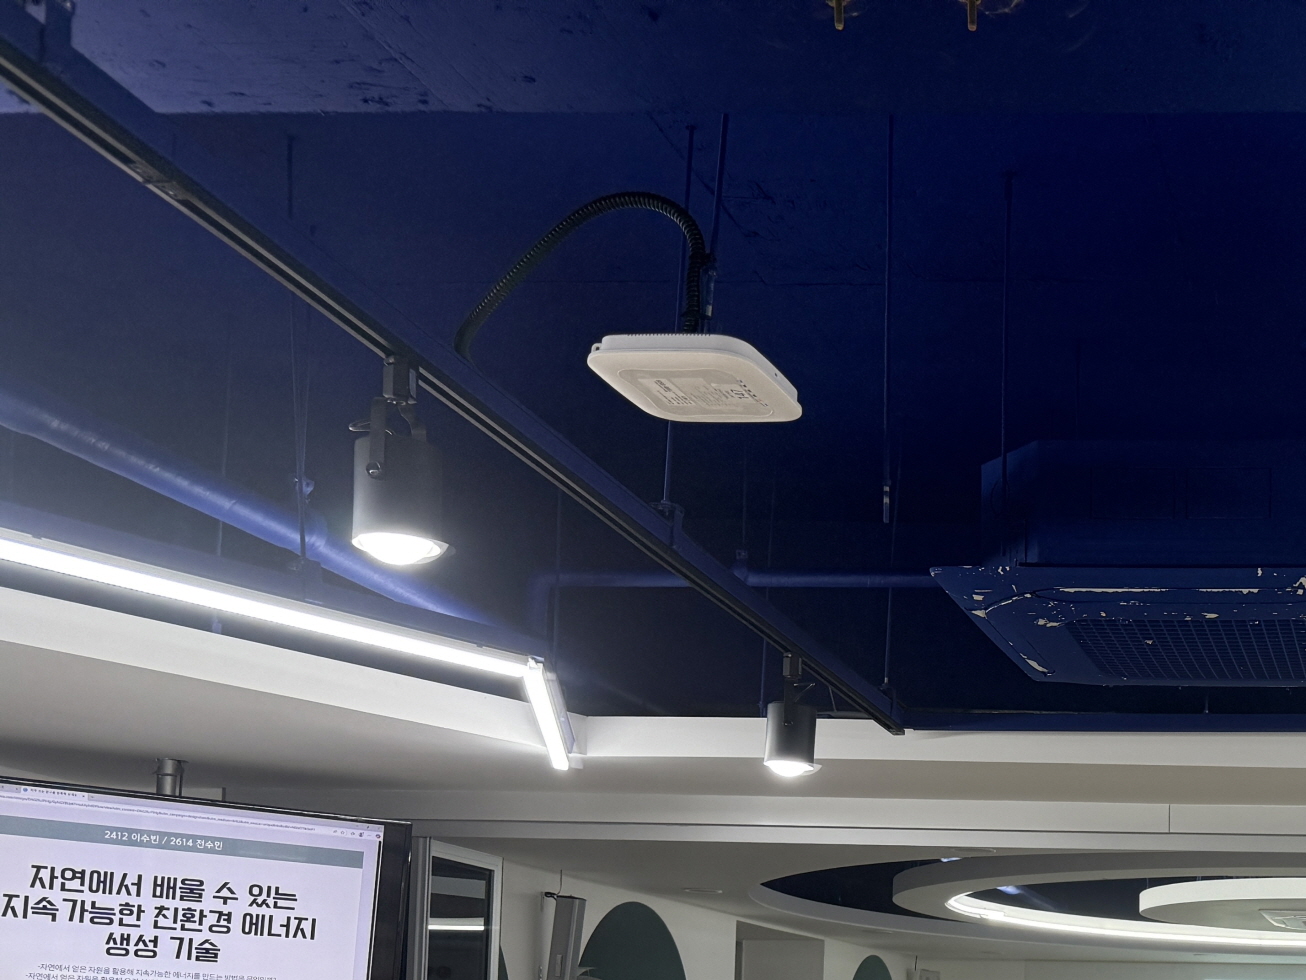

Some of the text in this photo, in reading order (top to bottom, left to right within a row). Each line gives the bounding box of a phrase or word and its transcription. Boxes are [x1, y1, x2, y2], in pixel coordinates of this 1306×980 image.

[104, 830, 129, 843] 2412
[131, 832, 160, 845] 이수빈
[170, 836, 194, 847] 2614
[29, 864, 298, 911] 자연에서 배울 수 있는
[1, 893, 317, 941] 지속가능한 친환경 에너지
[105, 932, 221, 963] 생성 기술
